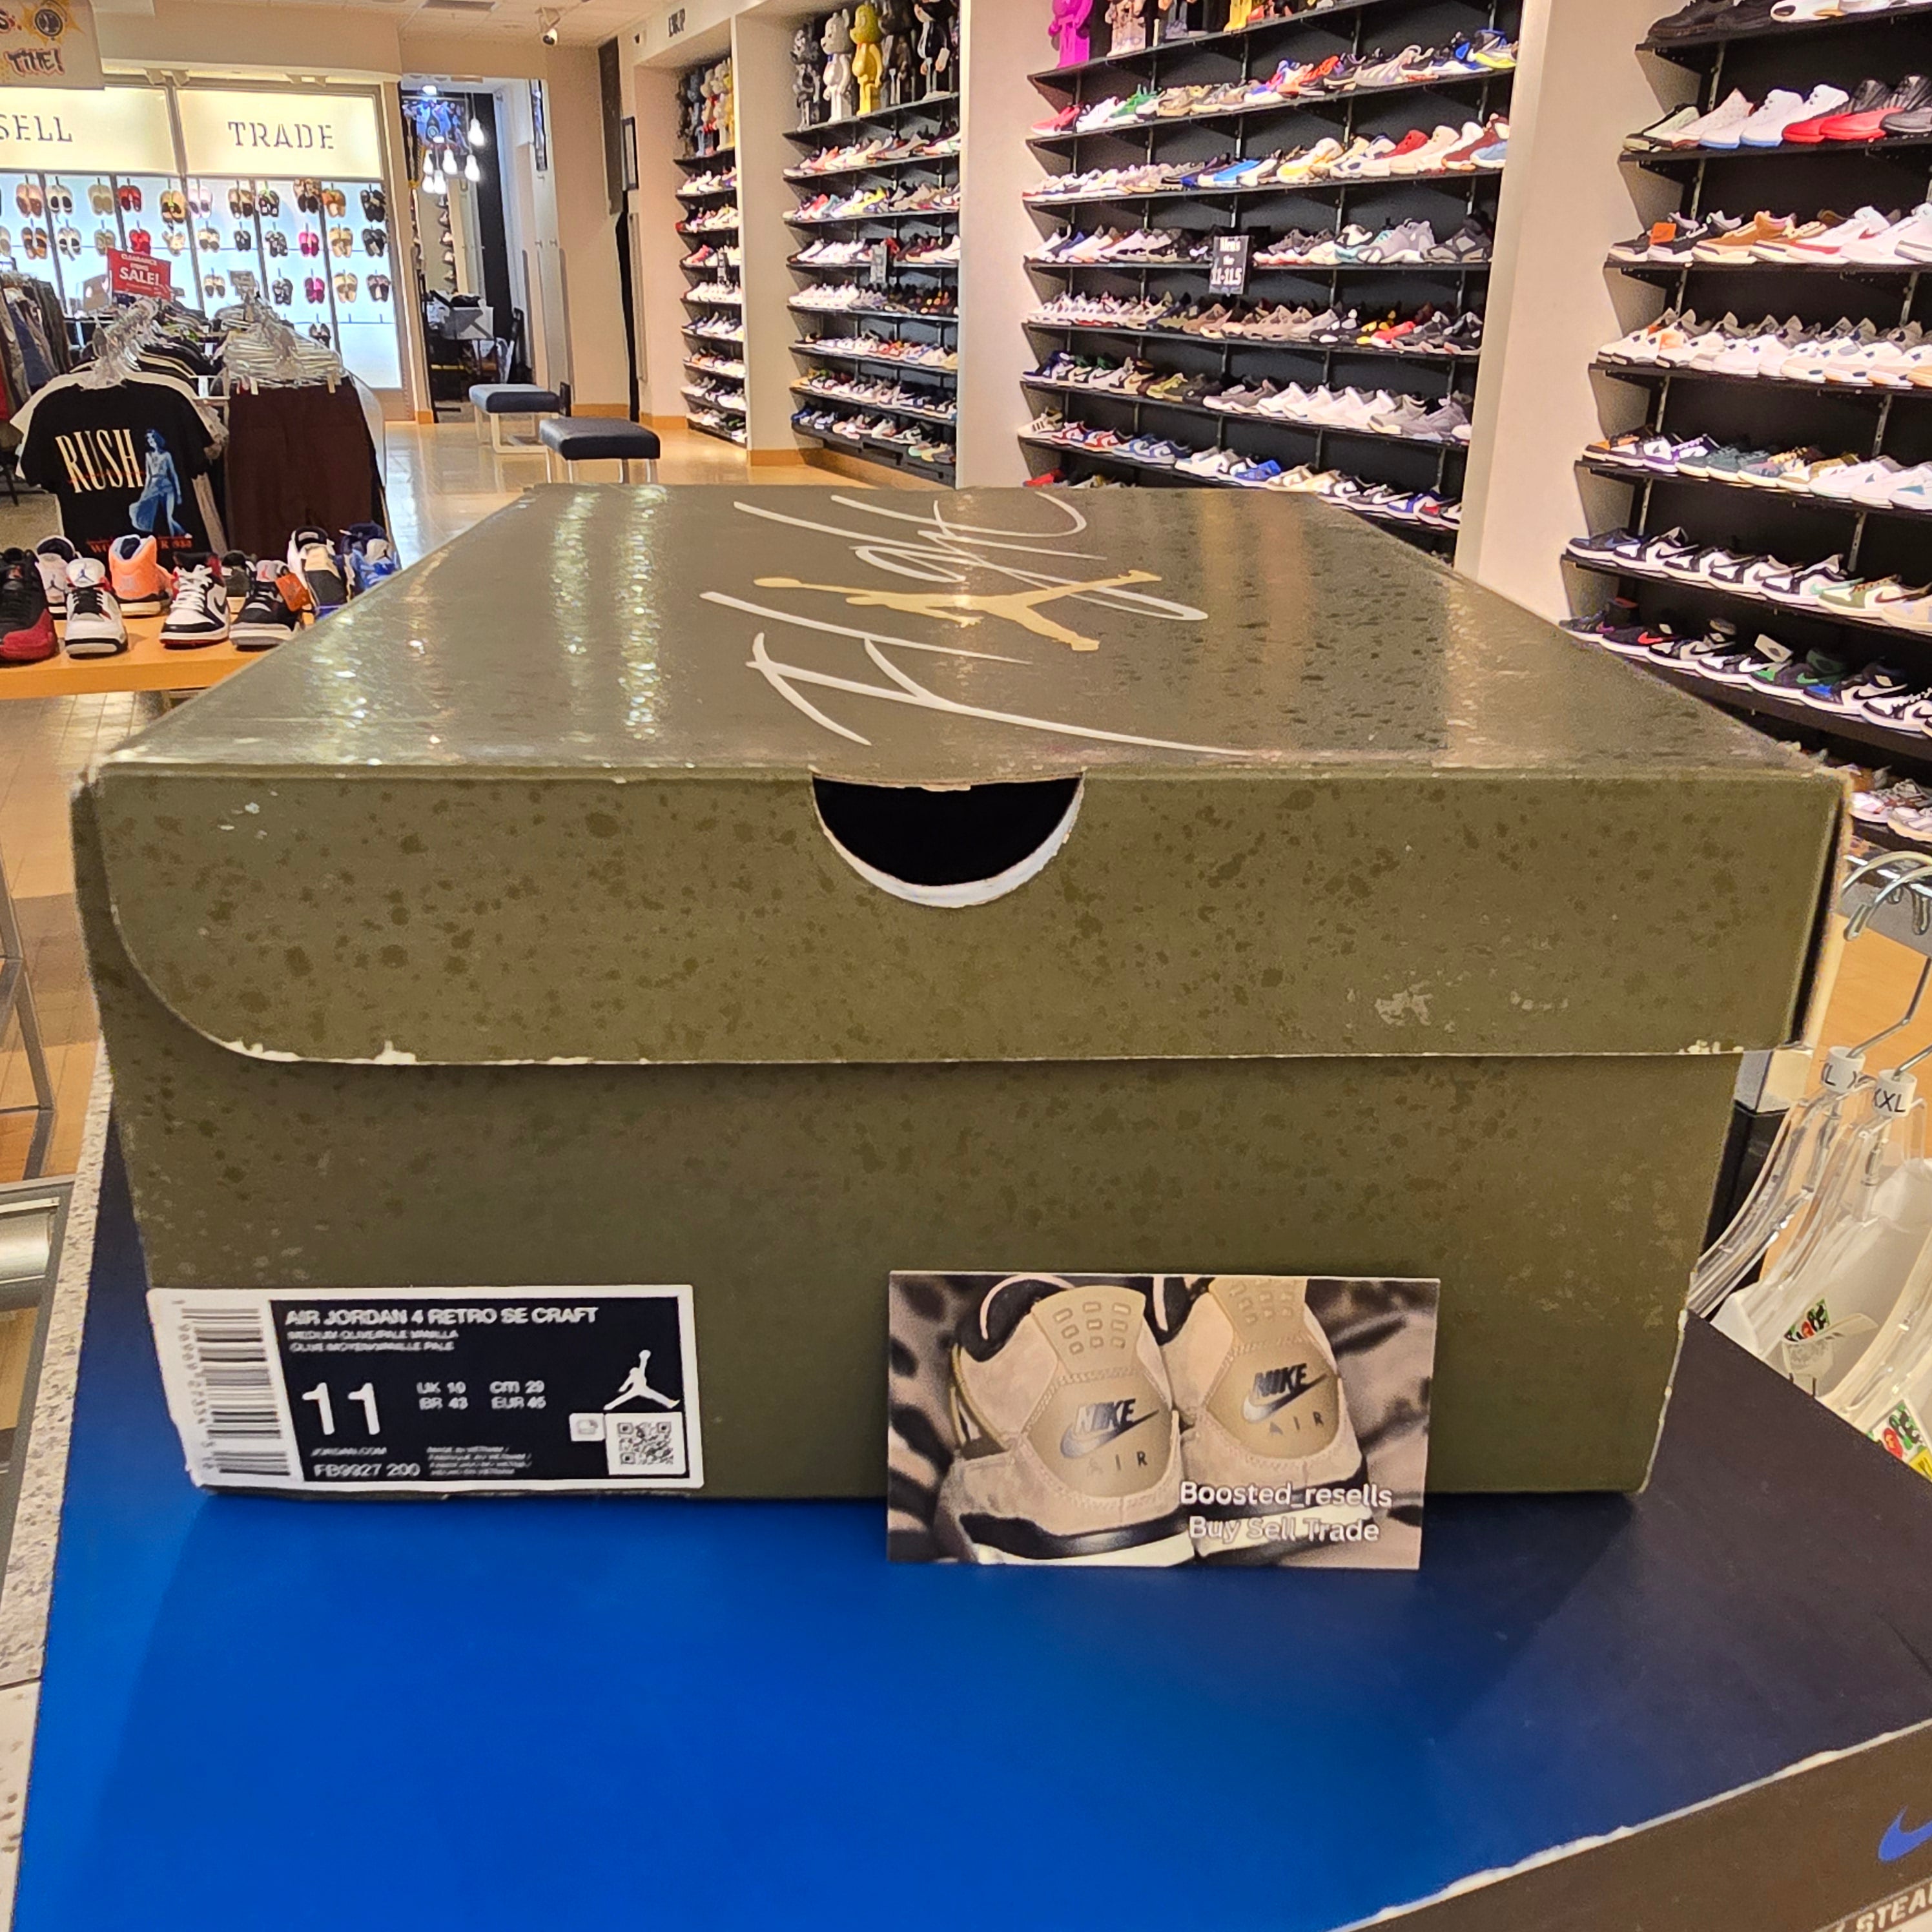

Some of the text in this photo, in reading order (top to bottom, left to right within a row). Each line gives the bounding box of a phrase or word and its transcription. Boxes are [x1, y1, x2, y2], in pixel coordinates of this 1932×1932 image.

[0, 114, 73, 142] SELL
[227, 121, 334, 149] TRADE
[55, 429, 143, 493] RUSH
[285, 1307, 599, 1326] AIR JORDAN 4 RETRO SE CRAFT
[416, 1381, 441, 1394] UK
[447, 1381, 466, 1394] 10
[1253, 1362, 1308, 1398] NIKE
[302, 1382, 381, 1435] 11
[419, 1397, 443, 1410] BR
[491, 1396, 524, 1410] EUR
[1074, 1398, 1136, 1434] NIKE
[1180, 1481, 1393, 1508] Boosted_resells
[1189, 1516, 1380, 1545] Buy Sell Trade
[1856, 1881, 1932, 1932] STEA
